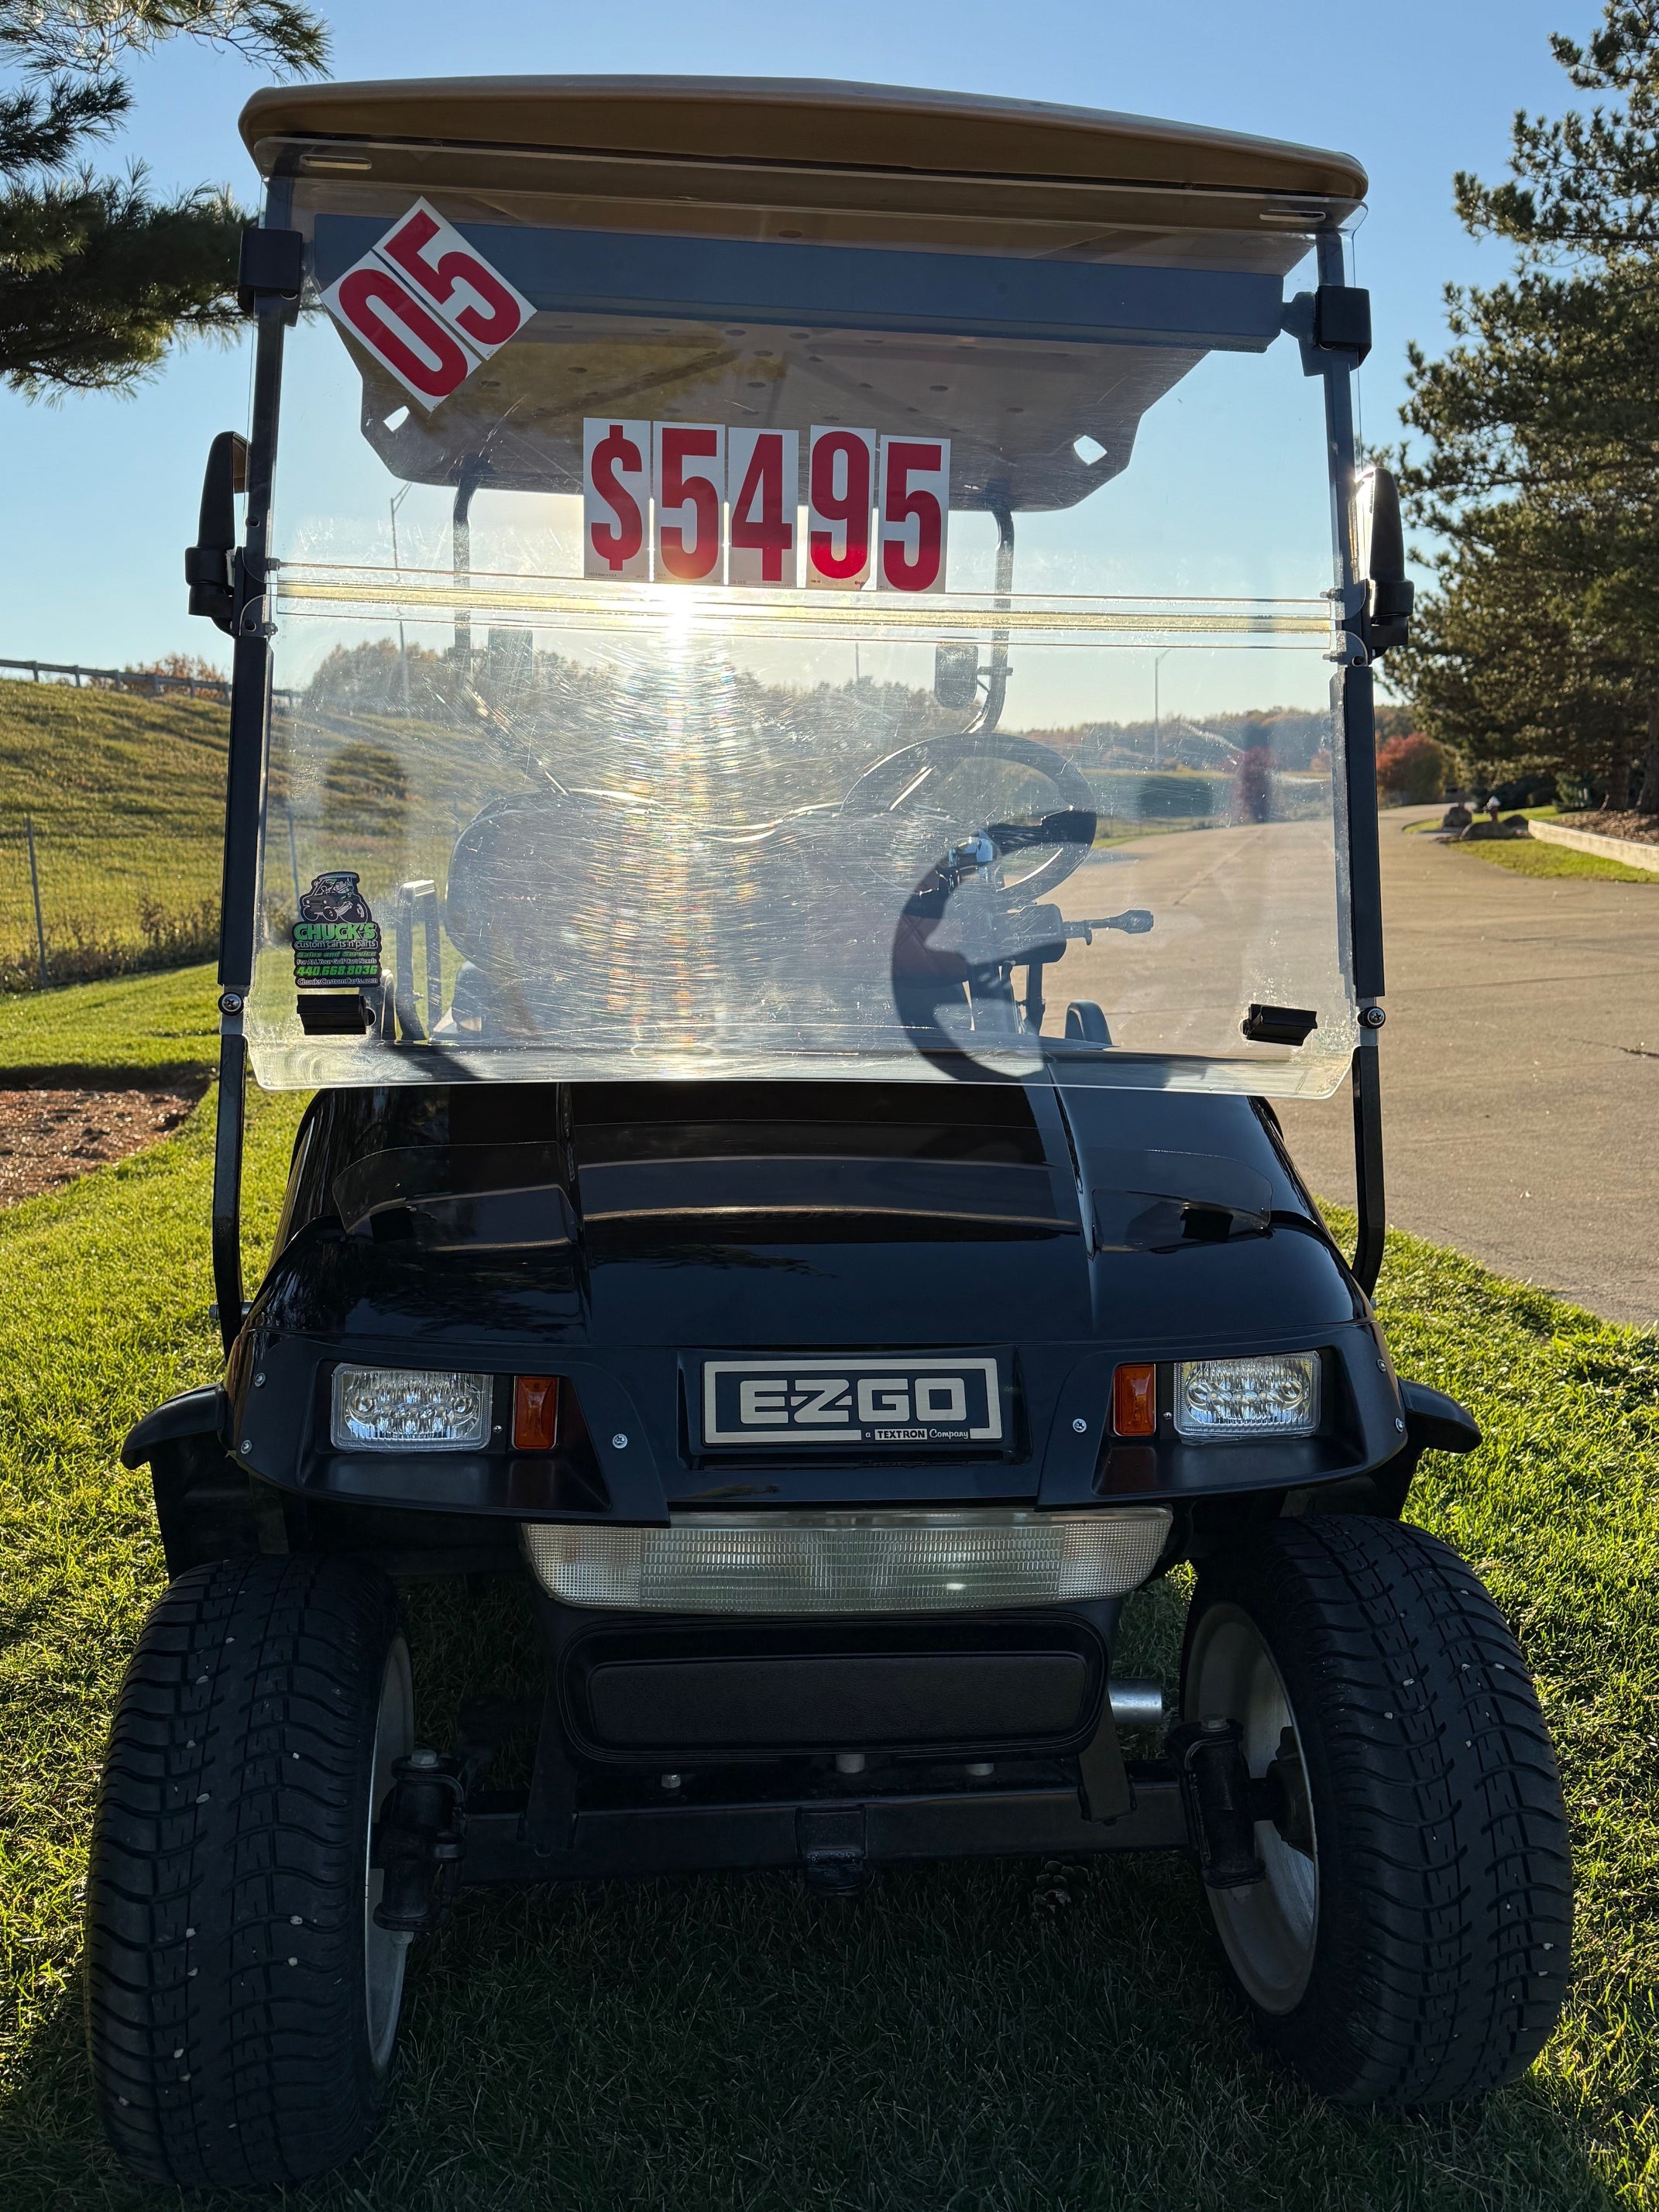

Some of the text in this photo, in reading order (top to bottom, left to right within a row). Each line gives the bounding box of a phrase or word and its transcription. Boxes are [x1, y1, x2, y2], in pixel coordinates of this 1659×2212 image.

[338, 209, 521, 397] 05
[590, 424, 941, 592] $5495
[294, 922, 376, 940] CHUCK'S
[356, 940, 376, 949] parts
[297, 965, 378, 976] 440.668.8036
[877, 1430, 926, 1439] TEXTRON
[929, 1428, 969, 1440] Company
